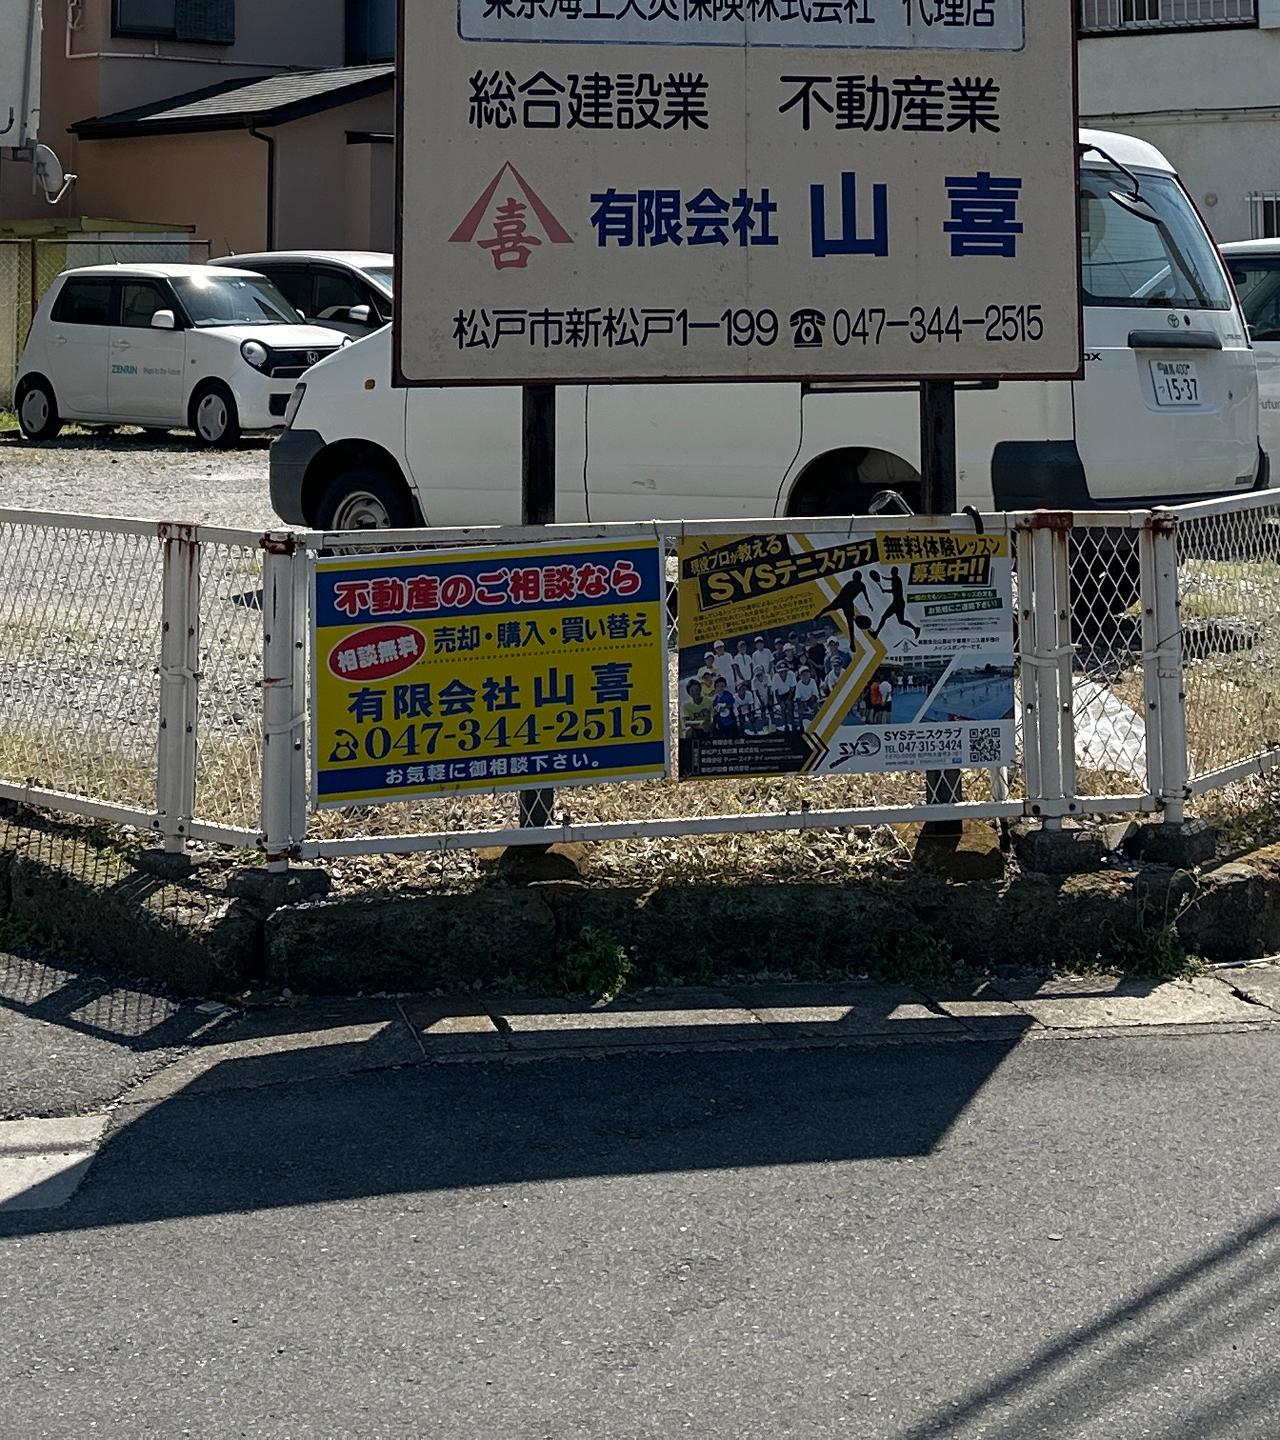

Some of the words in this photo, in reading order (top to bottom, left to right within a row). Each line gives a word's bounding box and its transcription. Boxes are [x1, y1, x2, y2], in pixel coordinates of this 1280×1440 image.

[469, 70, 710, 131] 総合建設業
[778, 73, 1001, 134] 不動産業
[590, 187, 779, 248] 有限会社
[833, 305, 1044, 346] 047-344-2515
[111, 364, 138, 375] ZENRIN
[882, 535, 1001, 560] 無料体験レッスン
[334, 560, 642, 617] 不動産のご相談なら
[706, 541, 872, 601] SYSテニスクラブ
[337, 634, 419, 673] 相談無料
[433, 612, 653, 654] 売却・購入・買い替え
[364, 703, 654, 760] 047-344-2515
[884, 727, 963, 741] SYSテニスクラブ
[385, 750, 601, 785] お気軽に御相談下さい。
